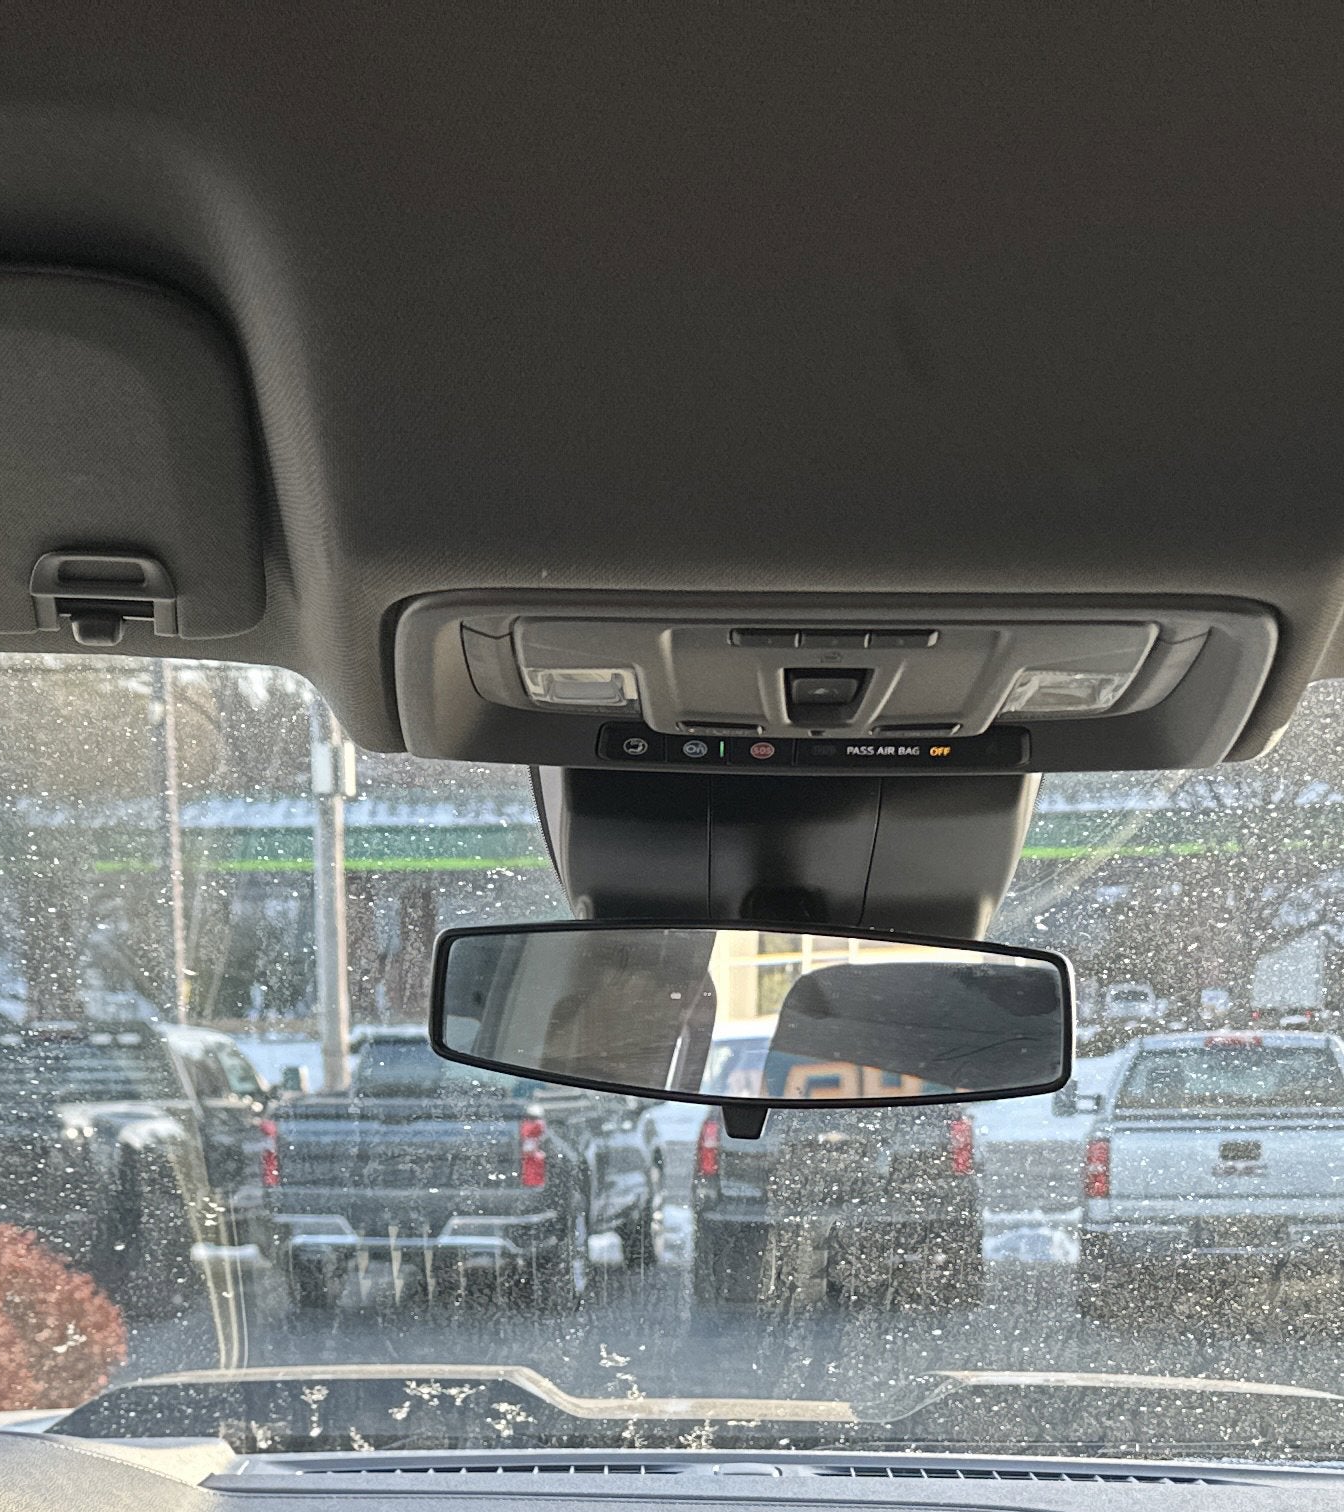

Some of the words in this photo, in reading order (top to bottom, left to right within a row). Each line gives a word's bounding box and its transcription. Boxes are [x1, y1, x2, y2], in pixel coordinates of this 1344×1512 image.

[846, 745, 874, 756] PASS
[877, 745, 895, 756] AIR
[898, 746, 921, 757] BAG
[929, 746, 951, 757] OFF
